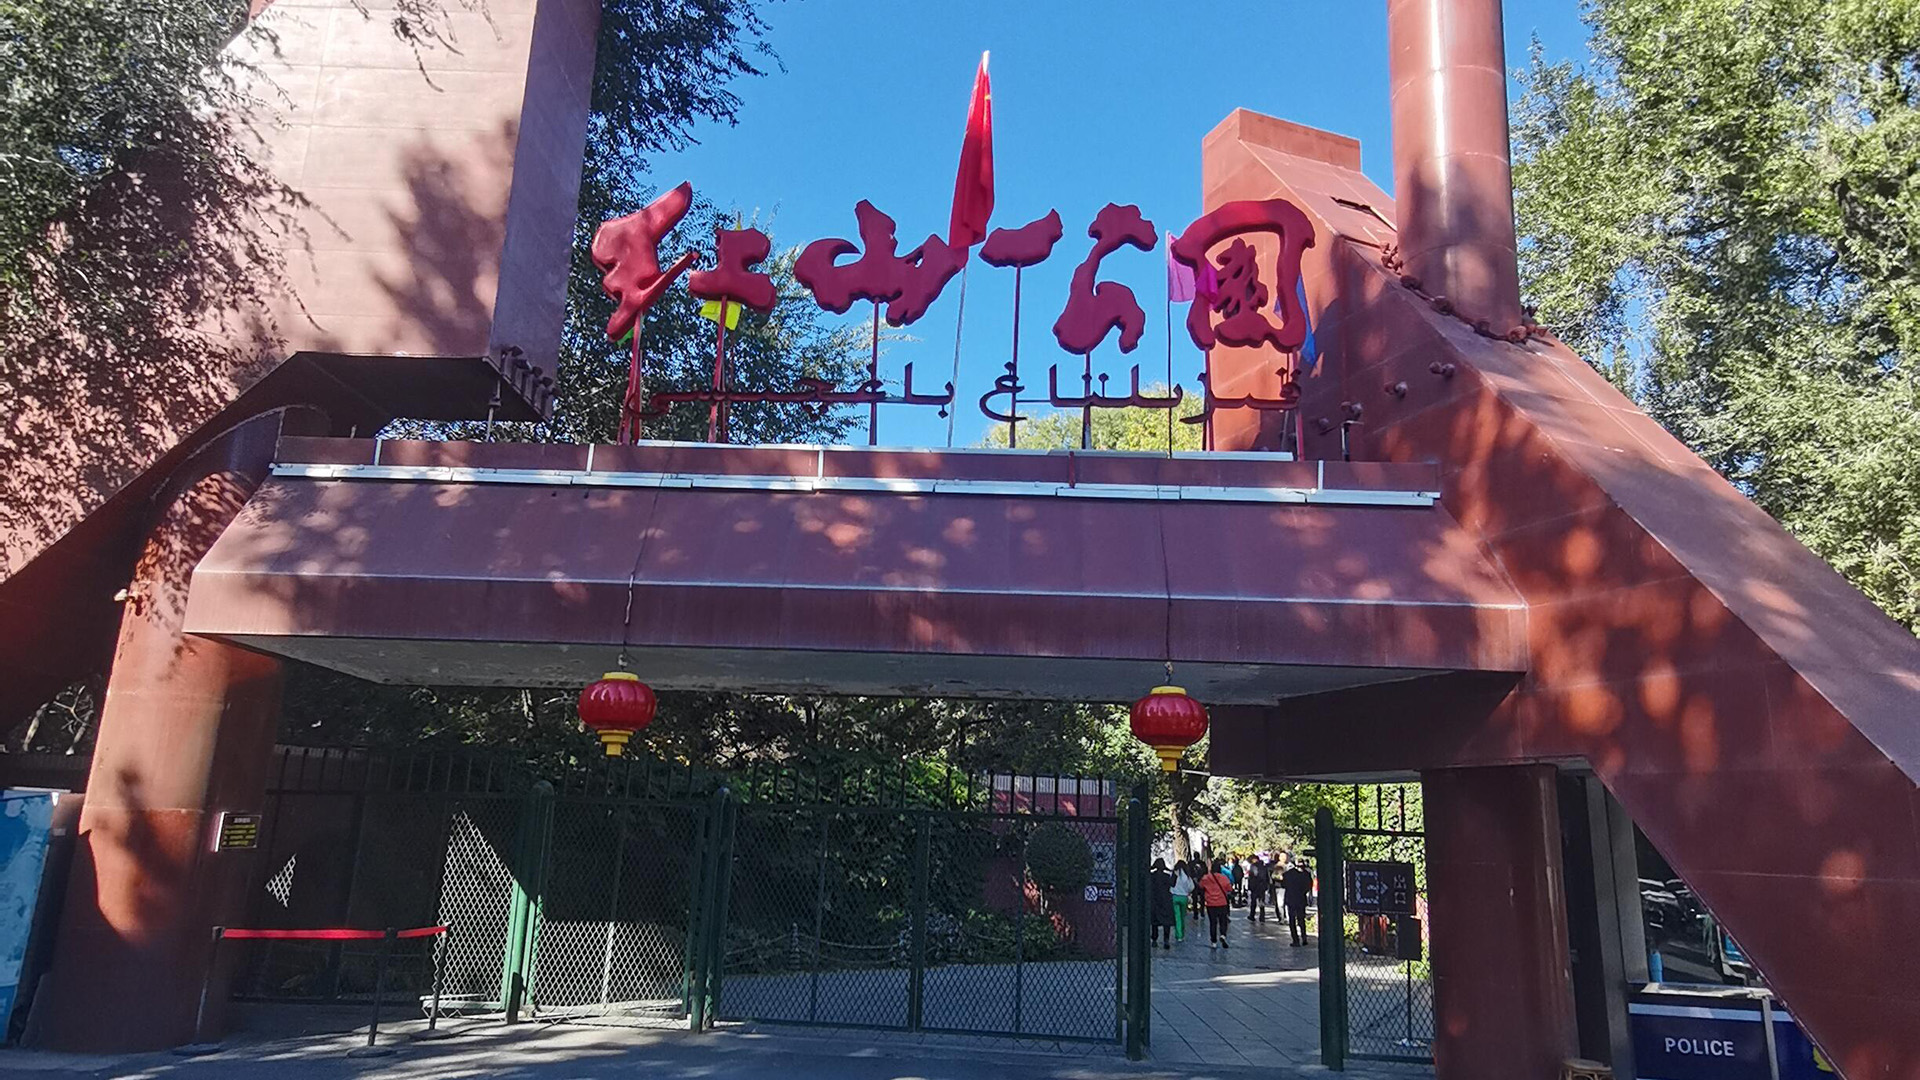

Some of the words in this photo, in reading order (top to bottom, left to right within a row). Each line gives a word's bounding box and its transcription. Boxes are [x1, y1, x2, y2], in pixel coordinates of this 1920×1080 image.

[592, 181, 1315, 353] 红山公园
[1664, 1037, 1735, 1056] POLICE
